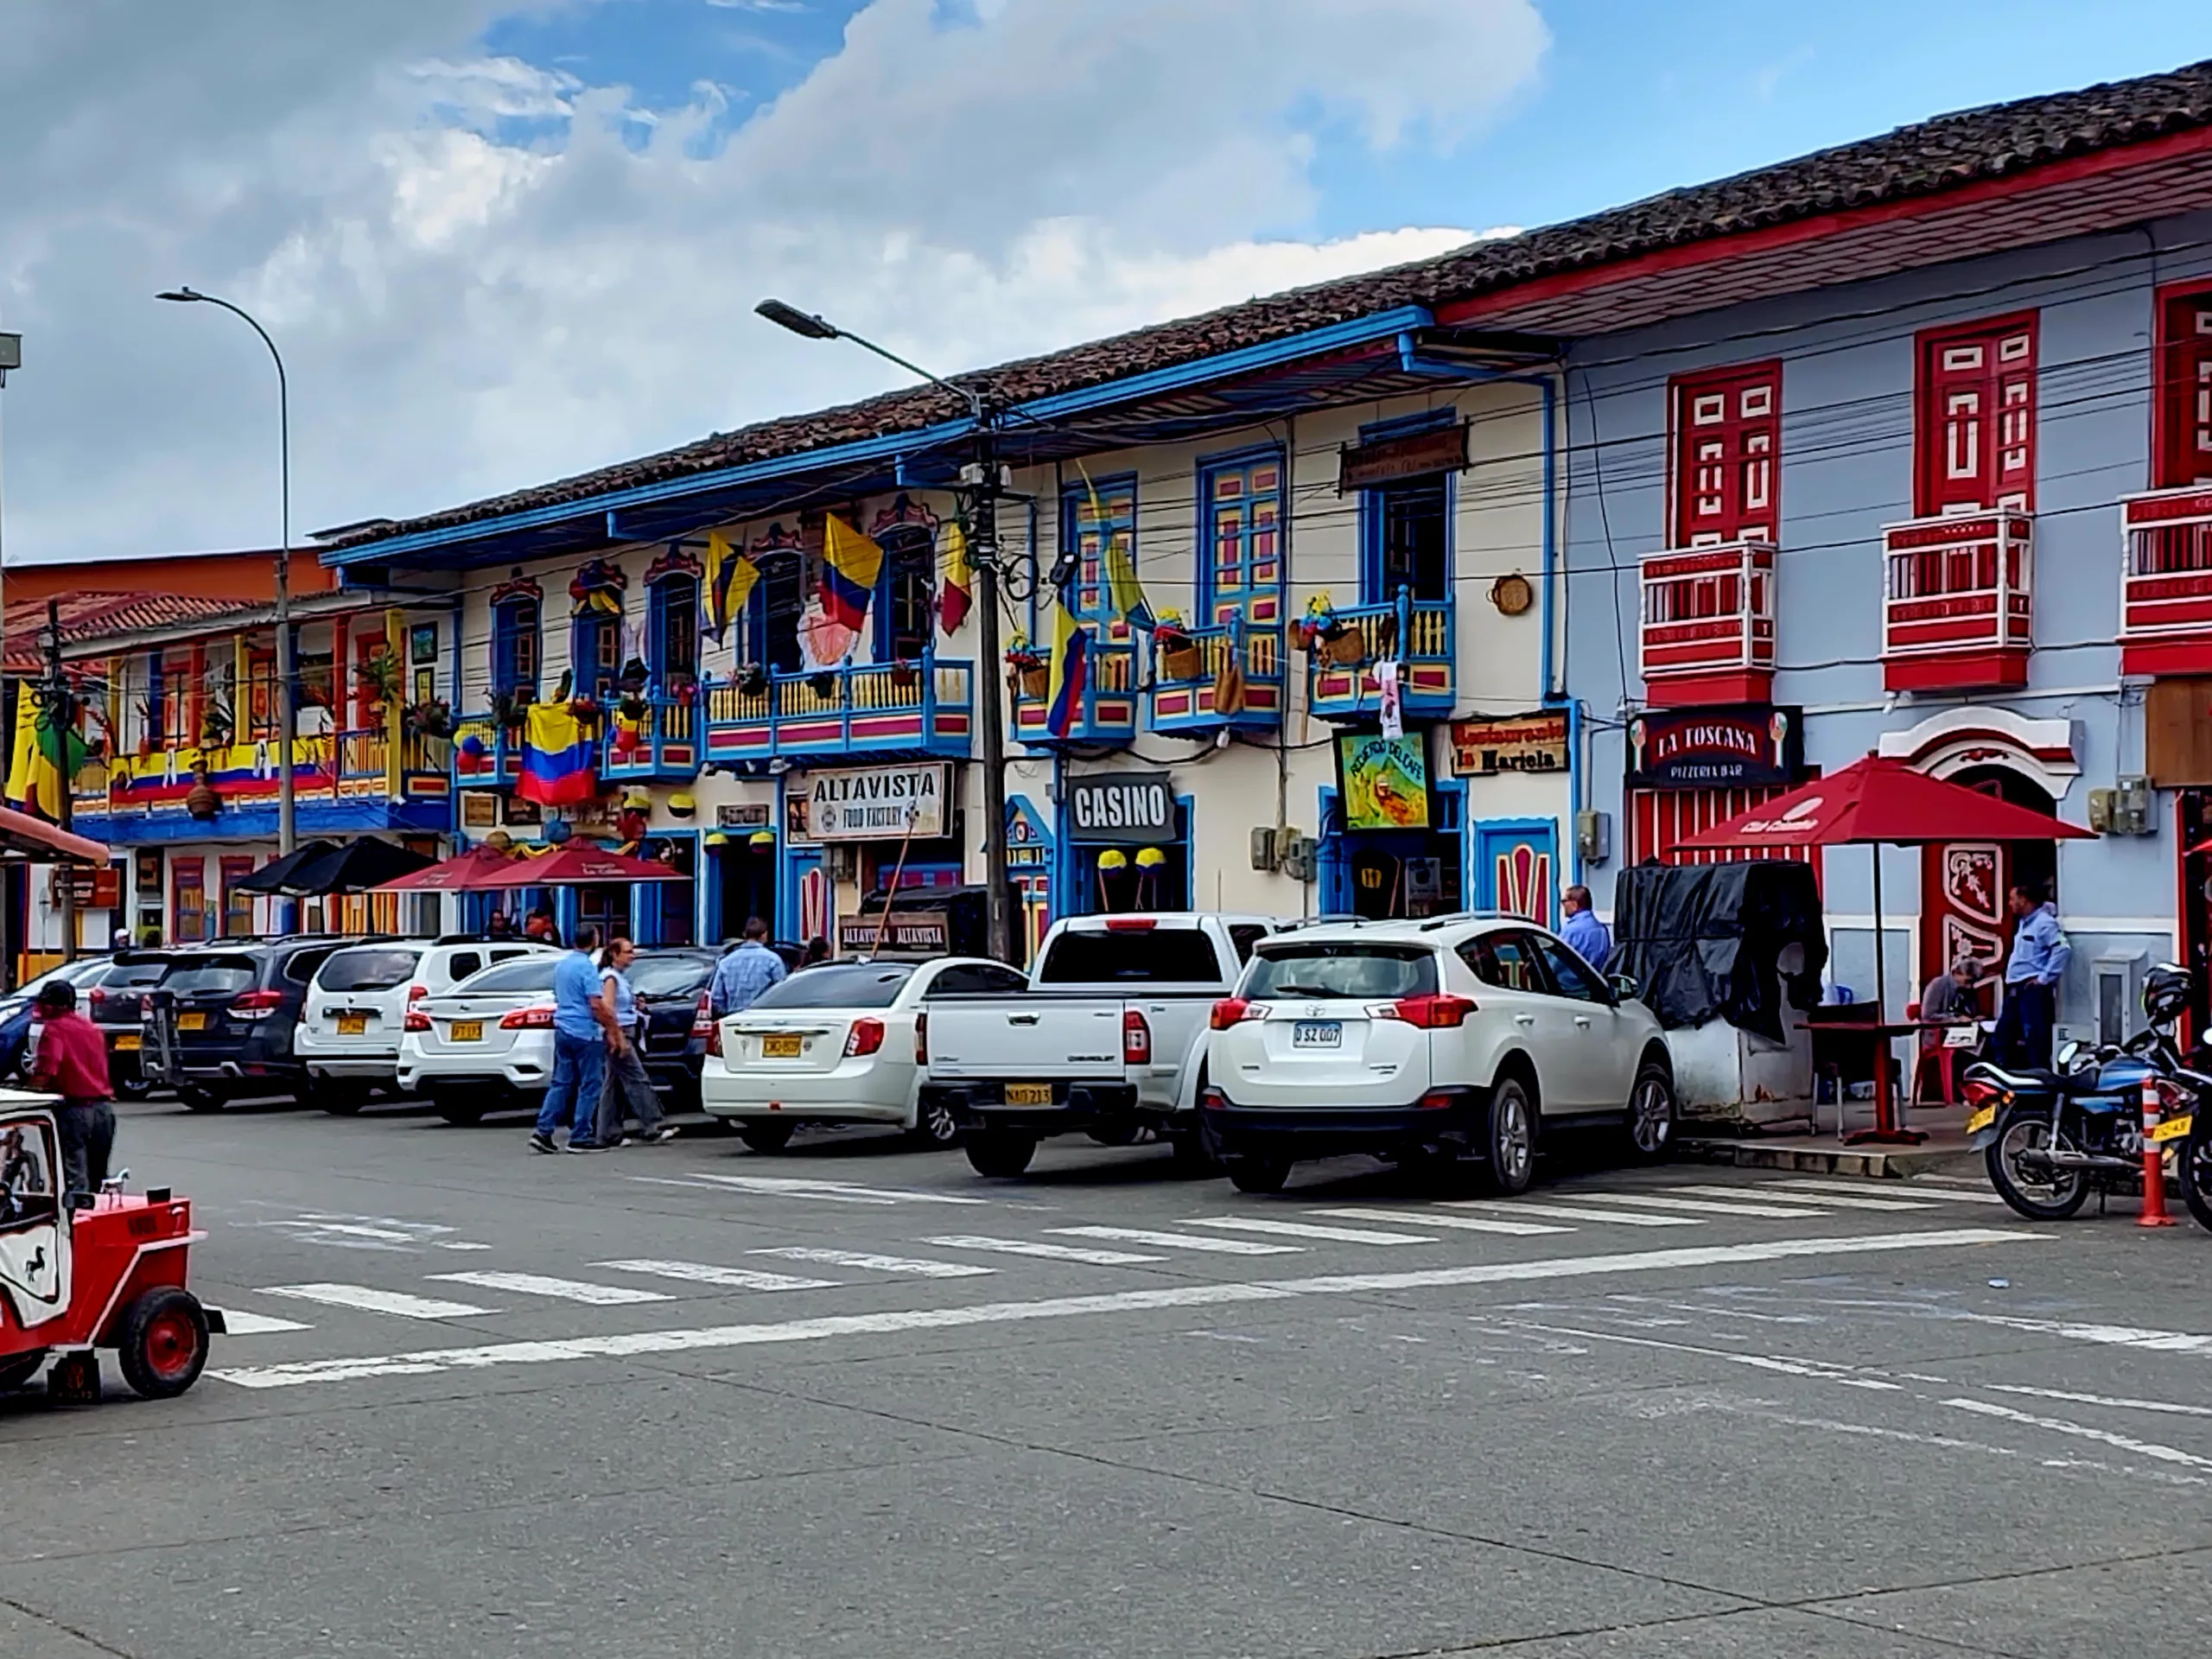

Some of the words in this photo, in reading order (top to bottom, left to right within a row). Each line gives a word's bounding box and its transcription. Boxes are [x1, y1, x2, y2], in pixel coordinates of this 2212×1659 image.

[1658, 734, 1678, 758] LA
[1686, 726, 1756, 754] TOSCANA
[1670, 766, 1718, 779] PIZZERIA
[1720, 764, 1743, 777] BAR
[813, 772, 935, 803] ALTAVISTA
[1075, 785, 1166, 827] CASINO
[843, 927, 890, 944] ALTAVIA
[897, 926, 943, 944] ALTAVISTA
